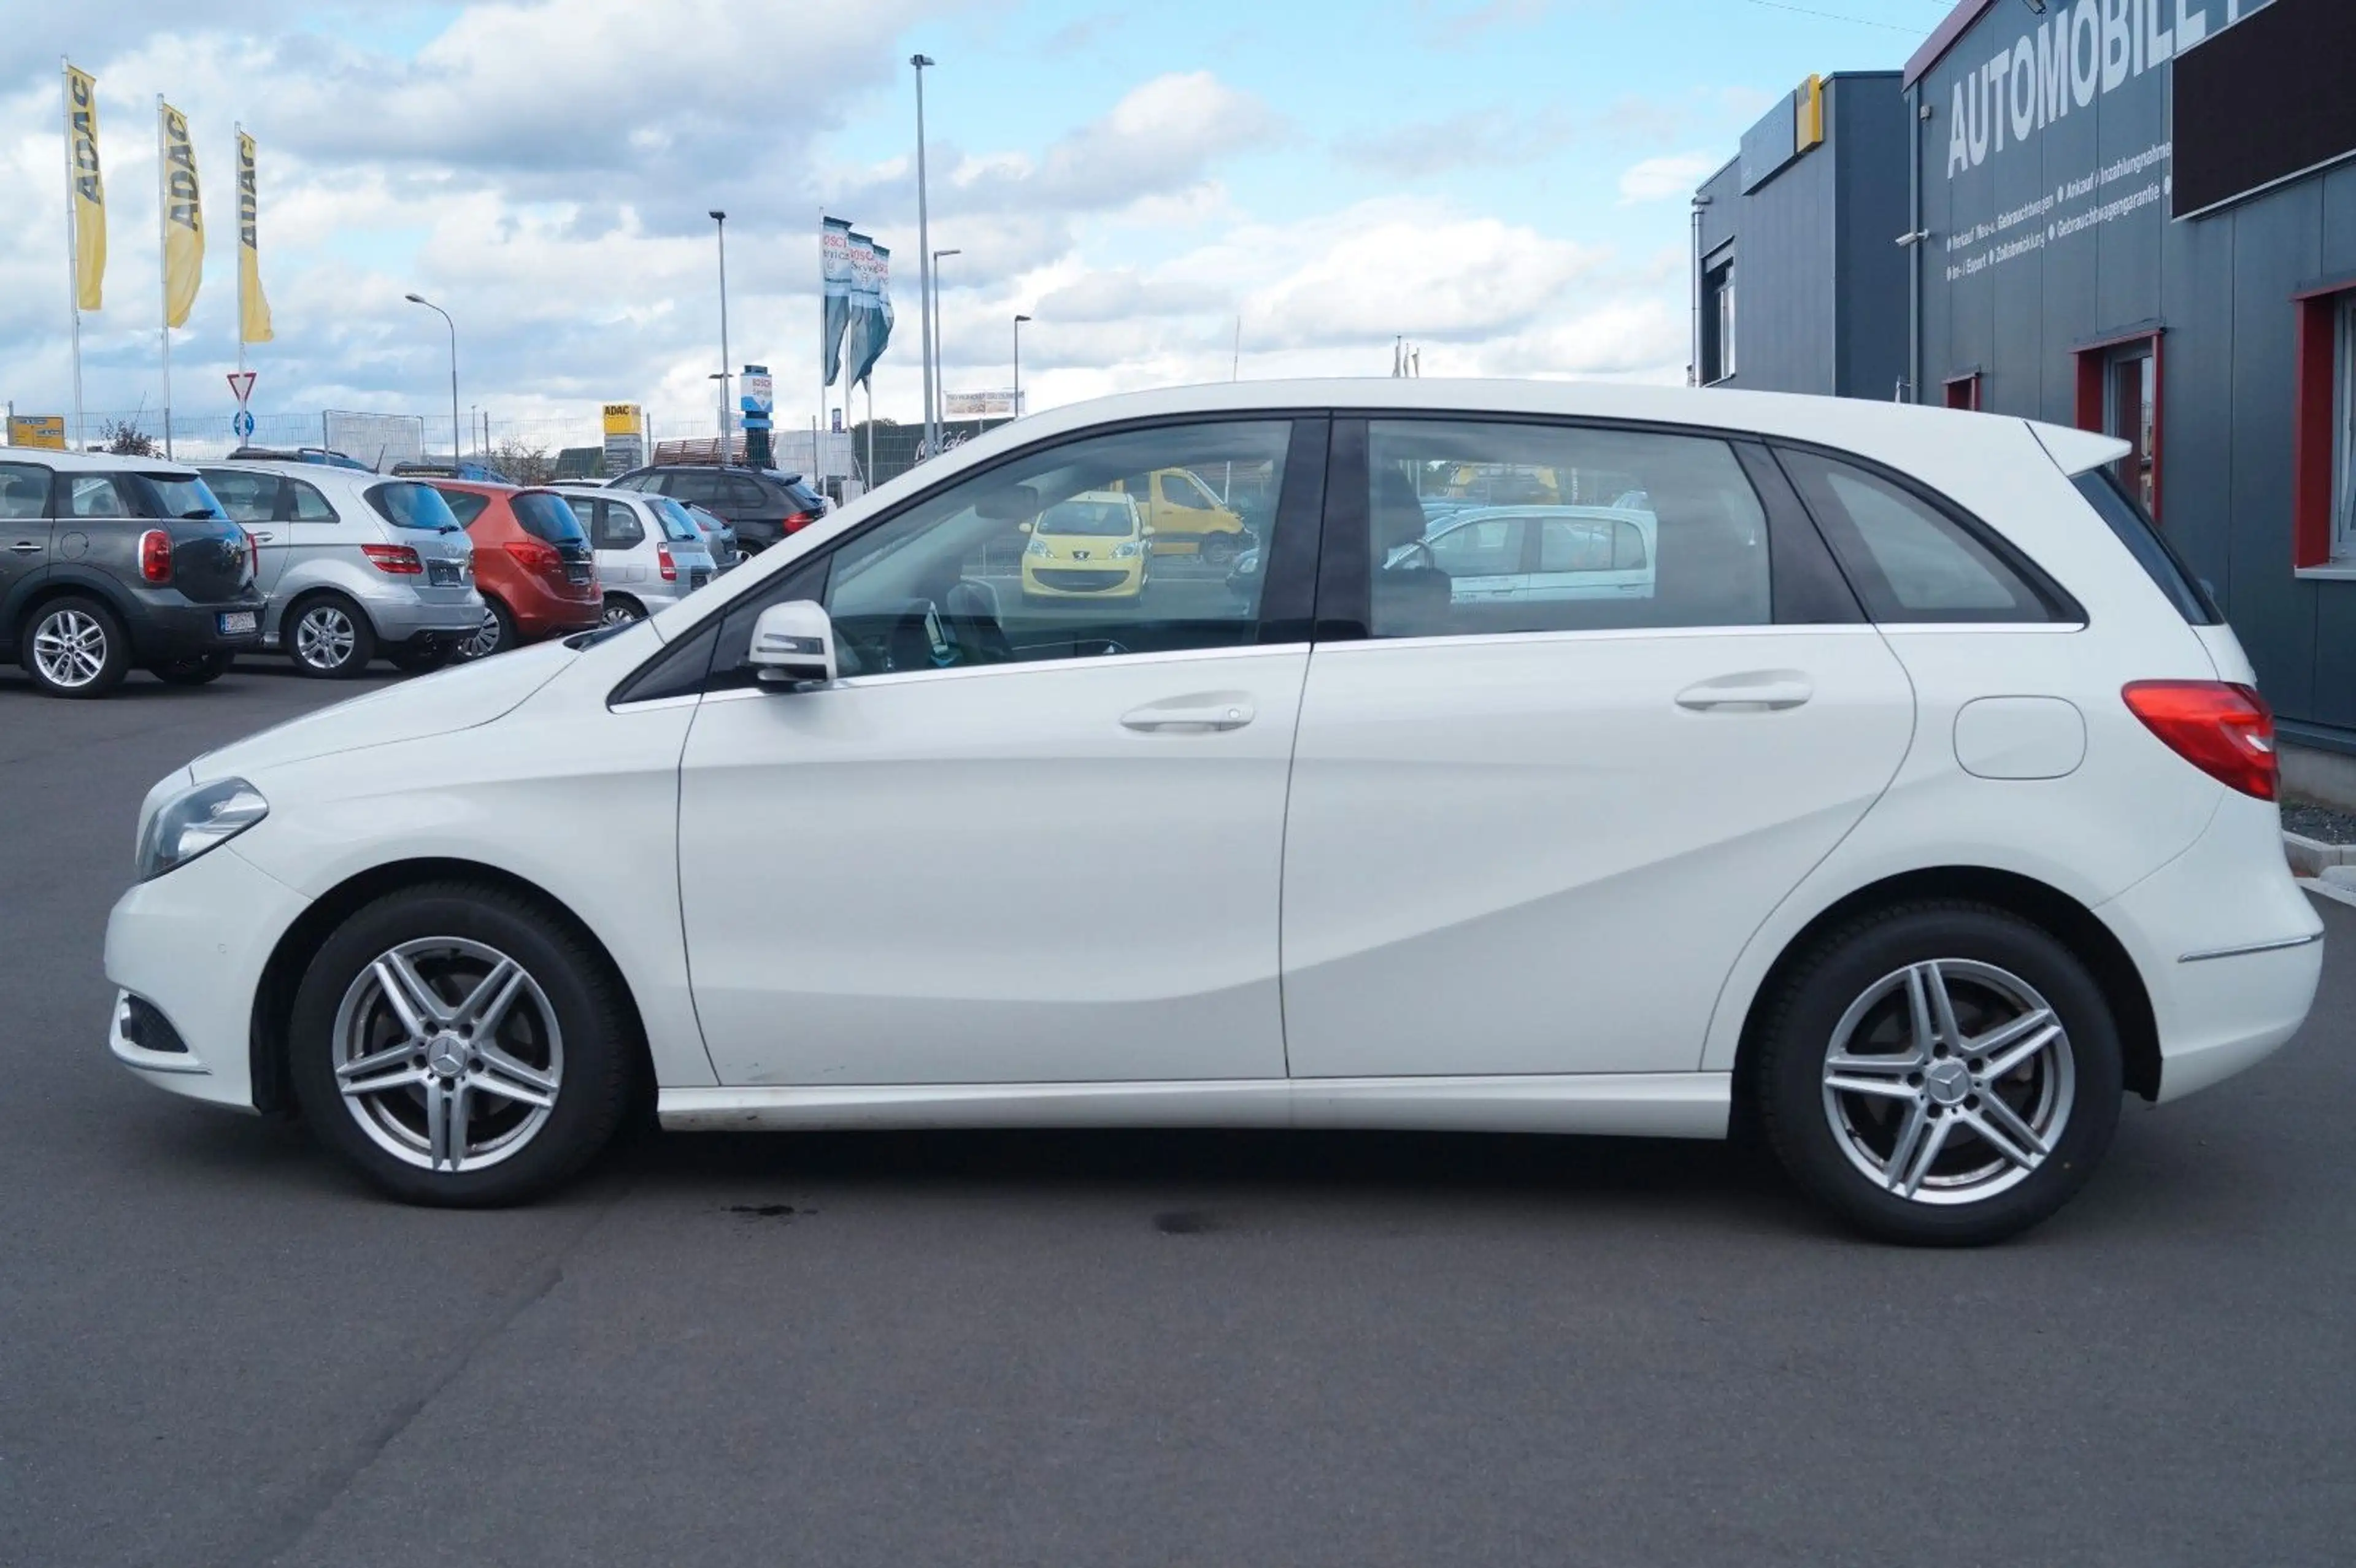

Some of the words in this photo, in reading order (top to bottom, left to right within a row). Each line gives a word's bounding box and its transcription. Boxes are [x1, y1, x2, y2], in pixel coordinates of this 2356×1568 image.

[72, 75, 101, 205] ADAC
[167, 112, 198, 232] ADAC
[2066, 171, 2094, 201] Ankauf
[2100, 141, 2171, 185] Inzahlungnahme
[240, 140, 256, 250] ADAC
[2057, 183, 2160, 238] Gebrauchtwagengarantie
[605, 405, 629, 416] ADAC
